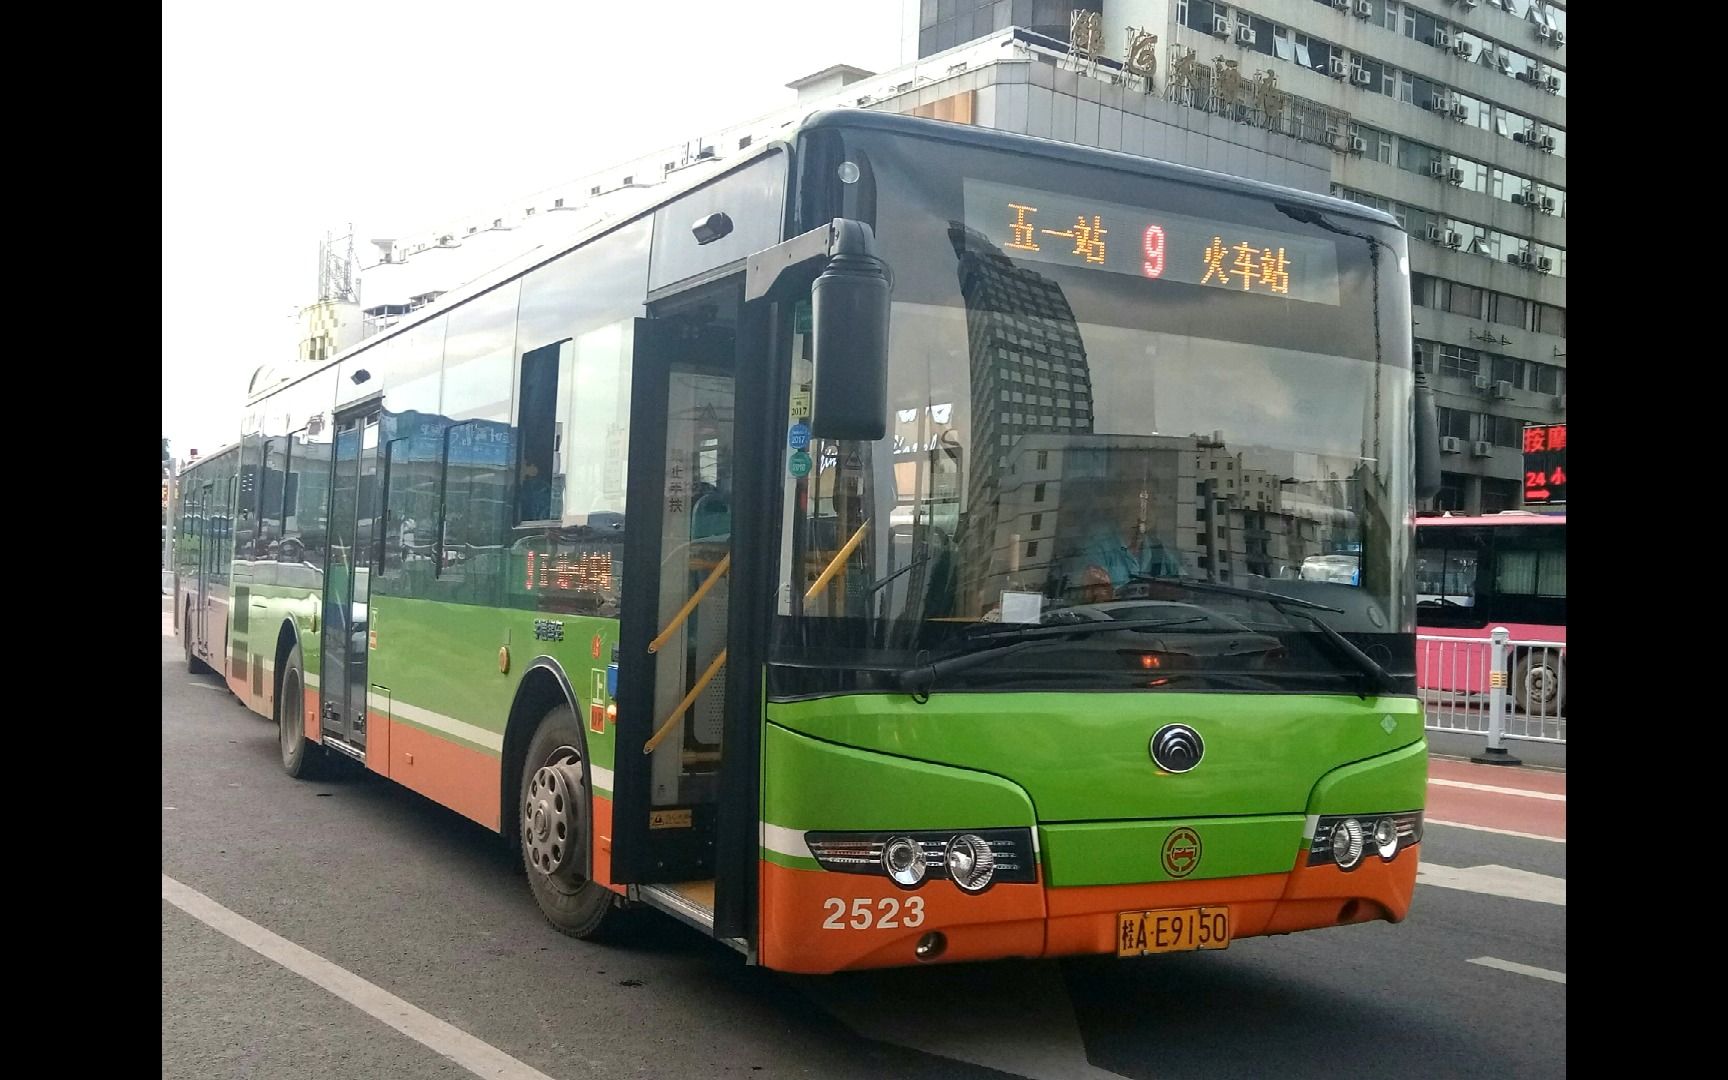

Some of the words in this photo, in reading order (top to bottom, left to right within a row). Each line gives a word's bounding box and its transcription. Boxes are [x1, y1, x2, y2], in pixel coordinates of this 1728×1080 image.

[1005, 203, 1107, 264] 五一站
[1144, 225, 1165, 278] 9
[1201, 236, 1291, 293] 火车站
[791, 407, 808, 416] 2017
[791, 435, 806, 444] 2017
[822, 896, 925, 930] 2523
